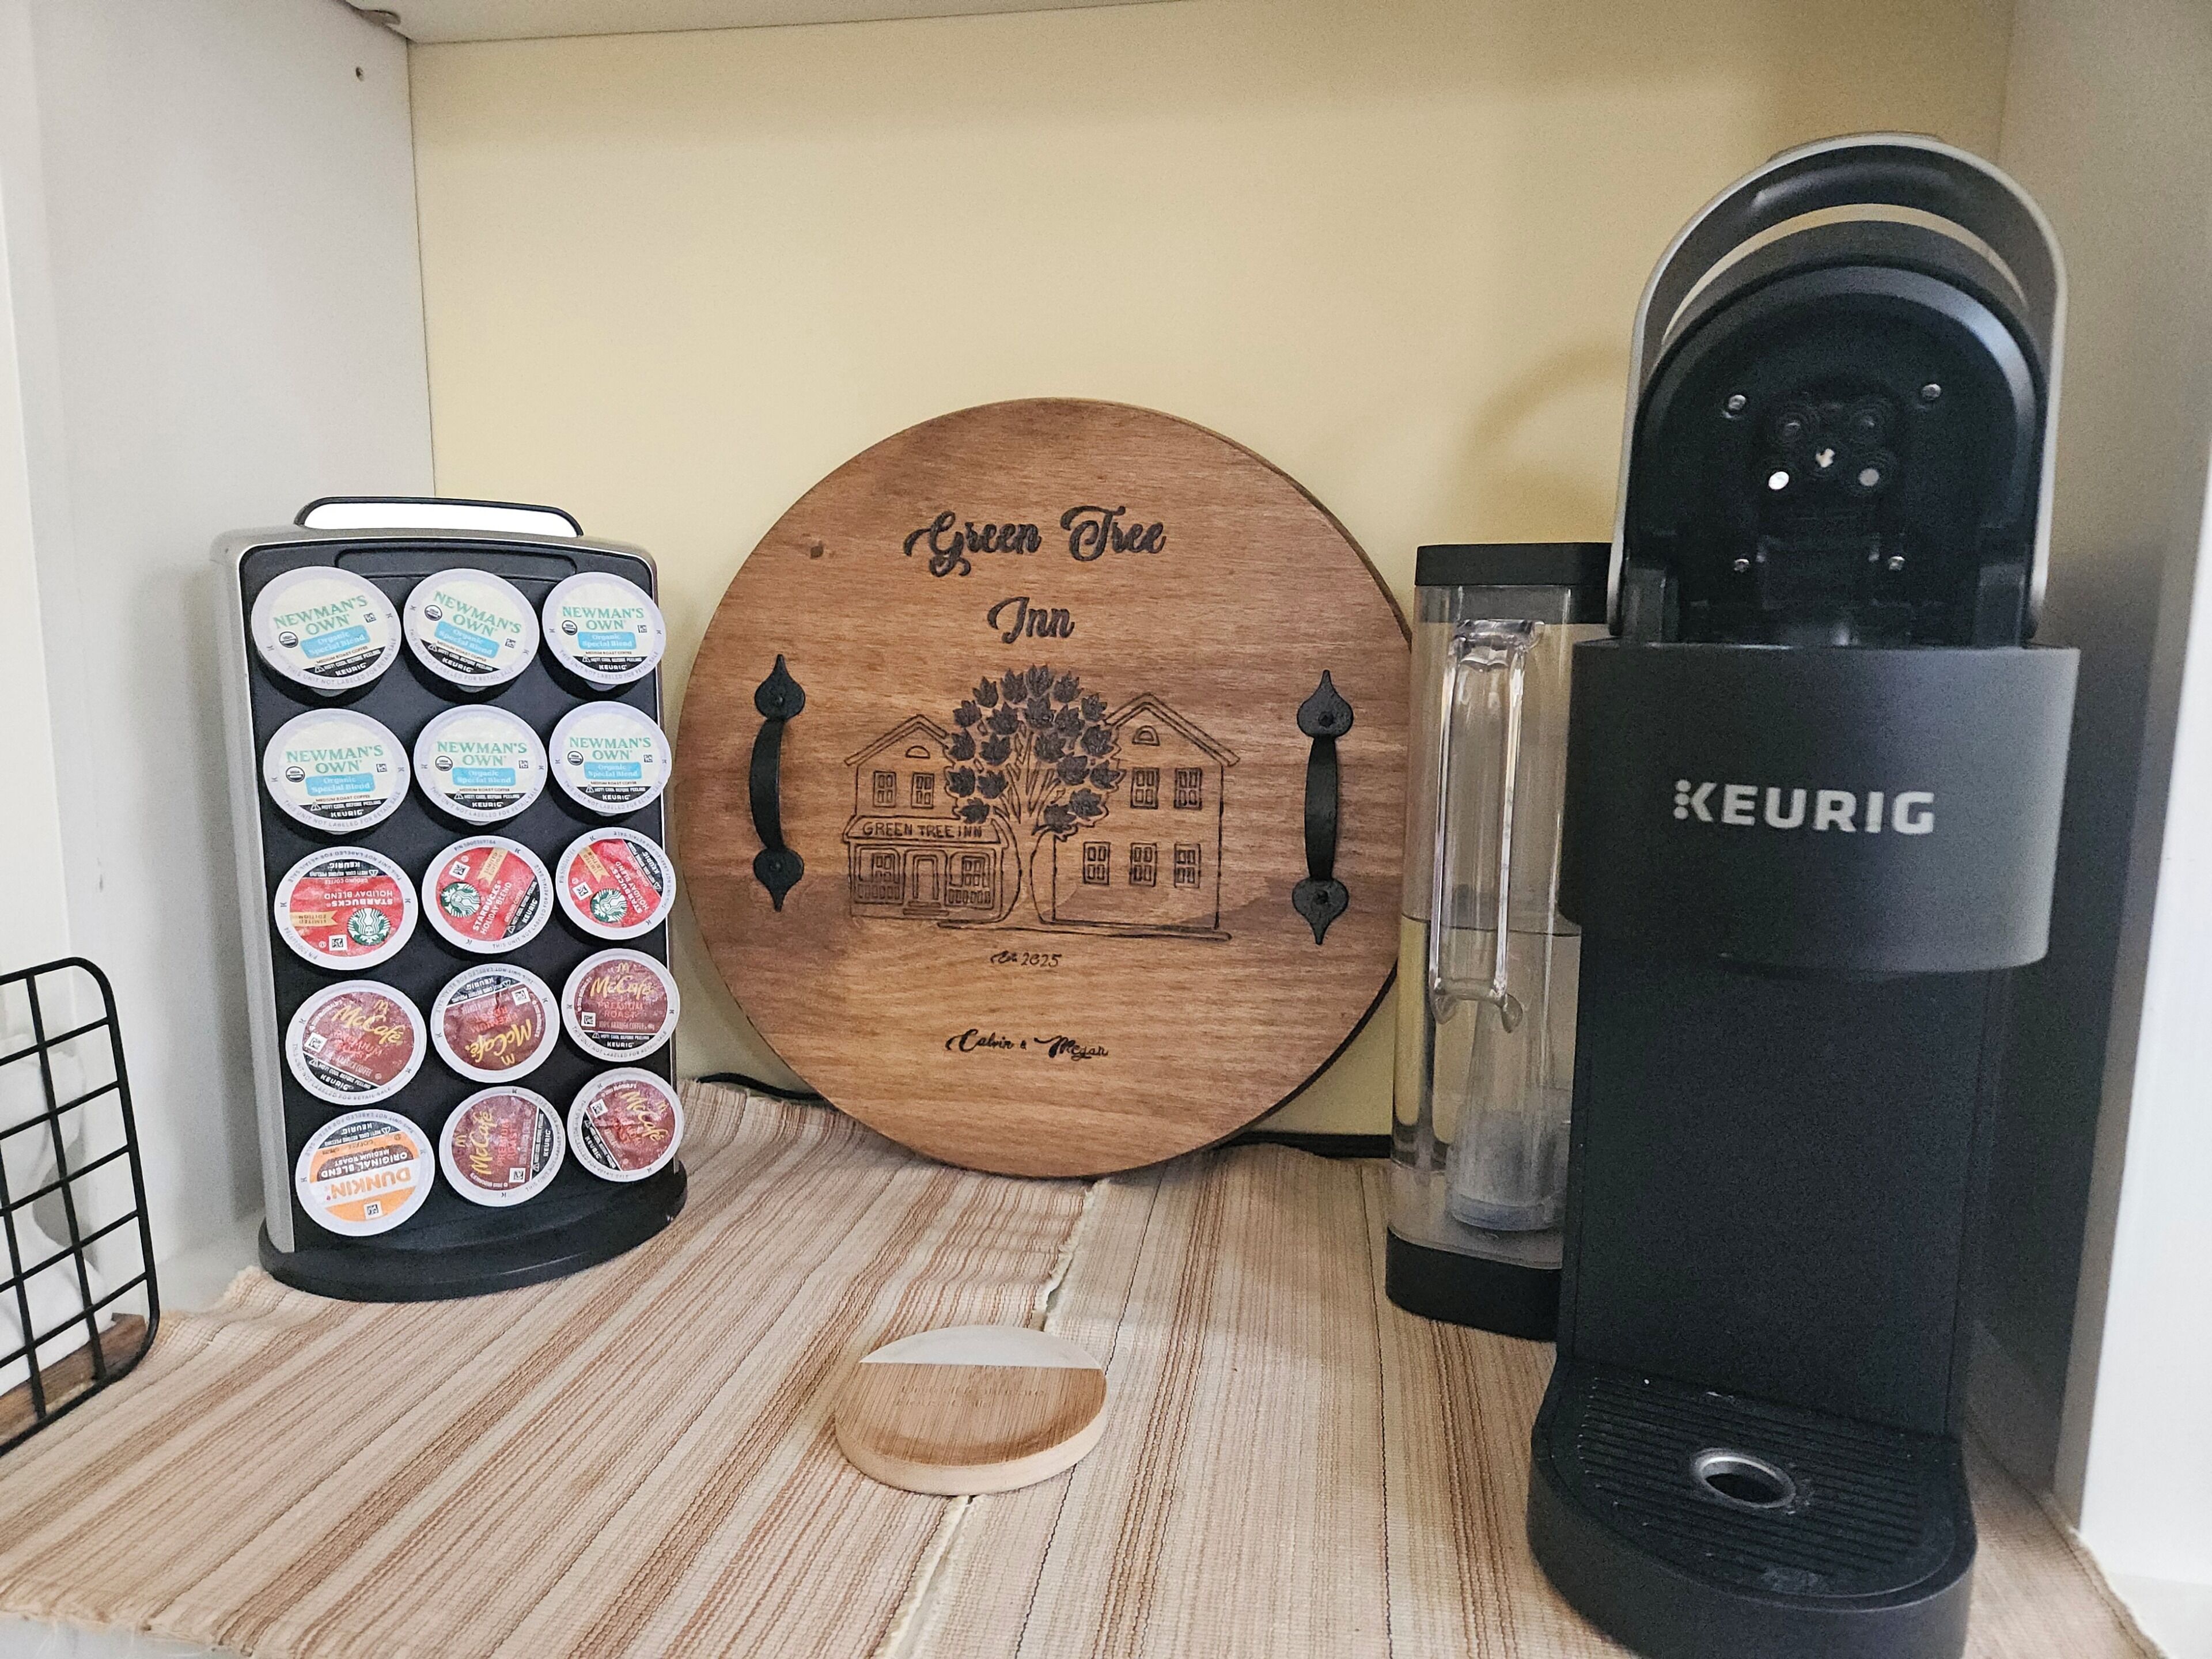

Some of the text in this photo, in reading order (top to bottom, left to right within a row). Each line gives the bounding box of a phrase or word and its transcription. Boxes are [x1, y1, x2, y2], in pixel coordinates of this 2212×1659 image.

[903, 505, 1167, 577] Green Tree
[273, 594, 368, 629] NEWMAN'S
[434, 590, 522, 634] NEWMAN'S
[562, 606, 644, 619] NEWMAN'S
[986, 596, 1075, 644] Inn
[305, 614, 349, 635] OWN
[453, 613, 495, 637] OWN
[586, 620, 624, 630] OWN
[318, 632, 351, 645] Organic
[452, 628, 484, 645] Organic
[582, 640, 610, 648] Special
[335, 662, 367, 676] KEURIG
[442, 657, 474, 673] KEURIG
[437, 741, 527, 753] NEWMAN'S
[569, 737, 652, 748] NEWMAN'S
[285, 744, 384, 763] NEWMAN'S
[461, 754, 504, 766] OWN
[592, 749, 630, 761] OWN
[315, 760, 360, 774] OWN
[311, 785, 344, 793] Special
[323, 777, 356, 785] Organic
[331, 809, 365, 818] KEURIG
[1673, 779, 1935, 834] KEURIG
[863, 821, 983, 838] GREEN TREE INN
[642, 851, 660, 875] KEURIG
[287, 870, 300, 882] SALE
[611, 865, 643, 914] STARBUCKS
[615, 861, 650, 911] HOLIDAY BLEND
[323, 891, 352, 899] BLEND
[330, 897, 393, 906] STARBUCKS
[472, 882, 502, 931] STARBUCKS
[480, 882, 512, 935] HOLIDAY BLEND
[504, 889, 524, 923] GROUND COFFEE
[521, 897, 539, 923] KEURIG
[521, 929, 532, 939] NOT
[466, 978, 494, 990] KEURIG
[597, 1002, 643, 1010] PREMIUM
[471, 1012, 518, 1033] PREMIUM
[334, 1030, 384, 1056] PREMIUM
[320, 1074, 349, 1090] KEURIG
[346, 1112, 374, 1120] LABELED
[340, 1123, 372, 1135] KEURIG
[497, 1118, 510, 1166] PREMIUM
[507, 1128, 517, 1159] ROAST
[543, 1129, 551, 1157] KEURIG
[584, 1135, 602, 1160] KEURIG
[321, 1152, 408, 1178] ORIGINAL BLEND
[335, 1148, 390, 1166] MEDIUM ROAST
